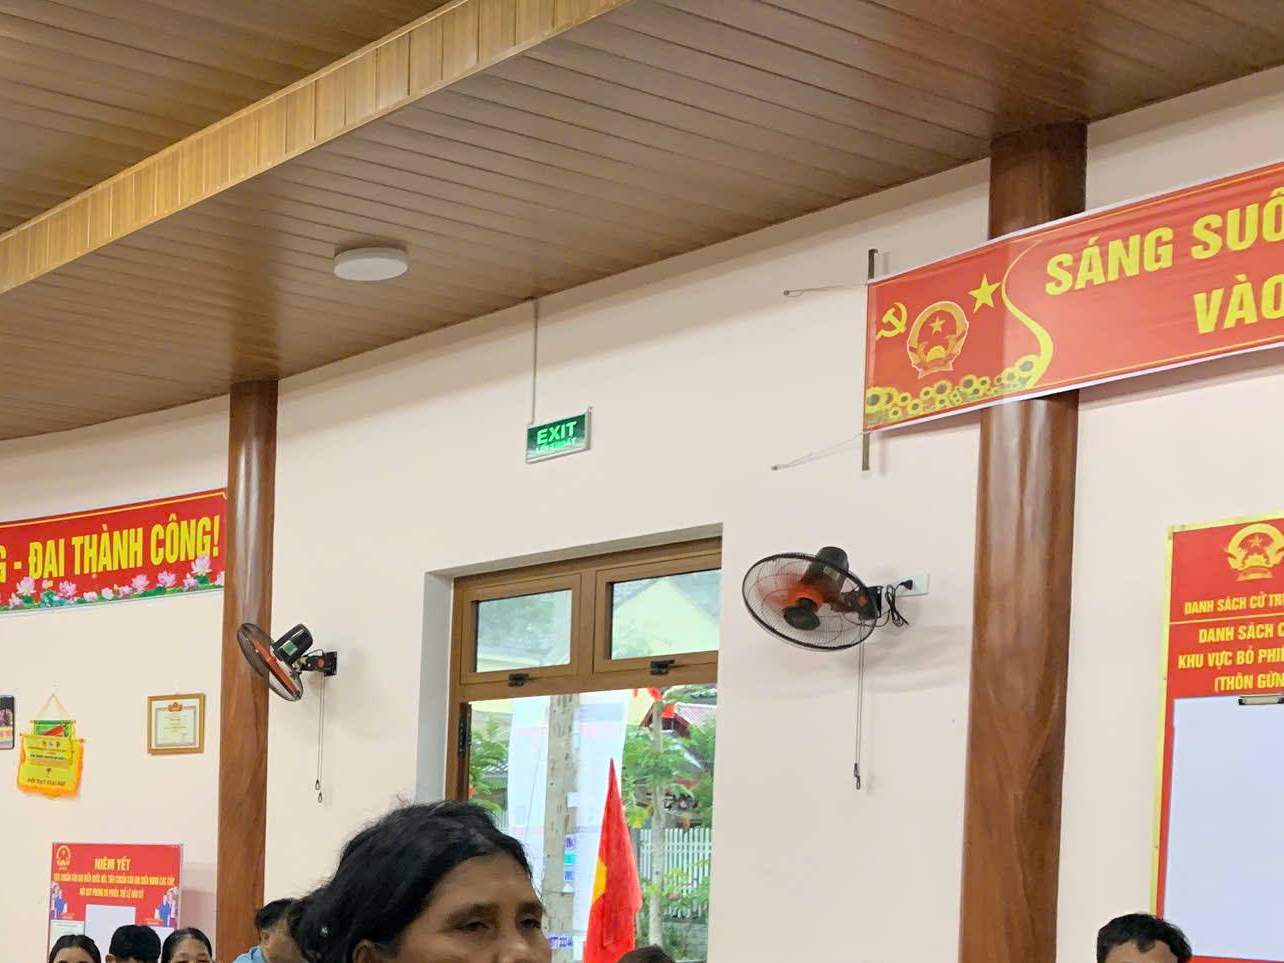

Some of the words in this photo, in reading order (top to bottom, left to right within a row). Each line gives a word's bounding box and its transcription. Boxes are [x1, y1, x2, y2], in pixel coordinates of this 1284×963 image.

[1045, 227, 1173, 296] SÁNG
[1193, 274, 1284, 334] VÀO
[537, 421, 577, 445] EXIT
[28, 539, 65, 586] ĐẠI
[72, 524, 143, 576] THÀNH
[150, 513, 220, 567] CÔNG!
[1185, 600, 1214, 615] DANH
[1217, 596, 1247, 611] SÁCH
[1199, 627, 1234, 643] DANH
[1238, 622, 1274, 640] SÁCH
[1178, 654, 1204, 669] KHU
[1207, 650, 1233, 670] VỰC
